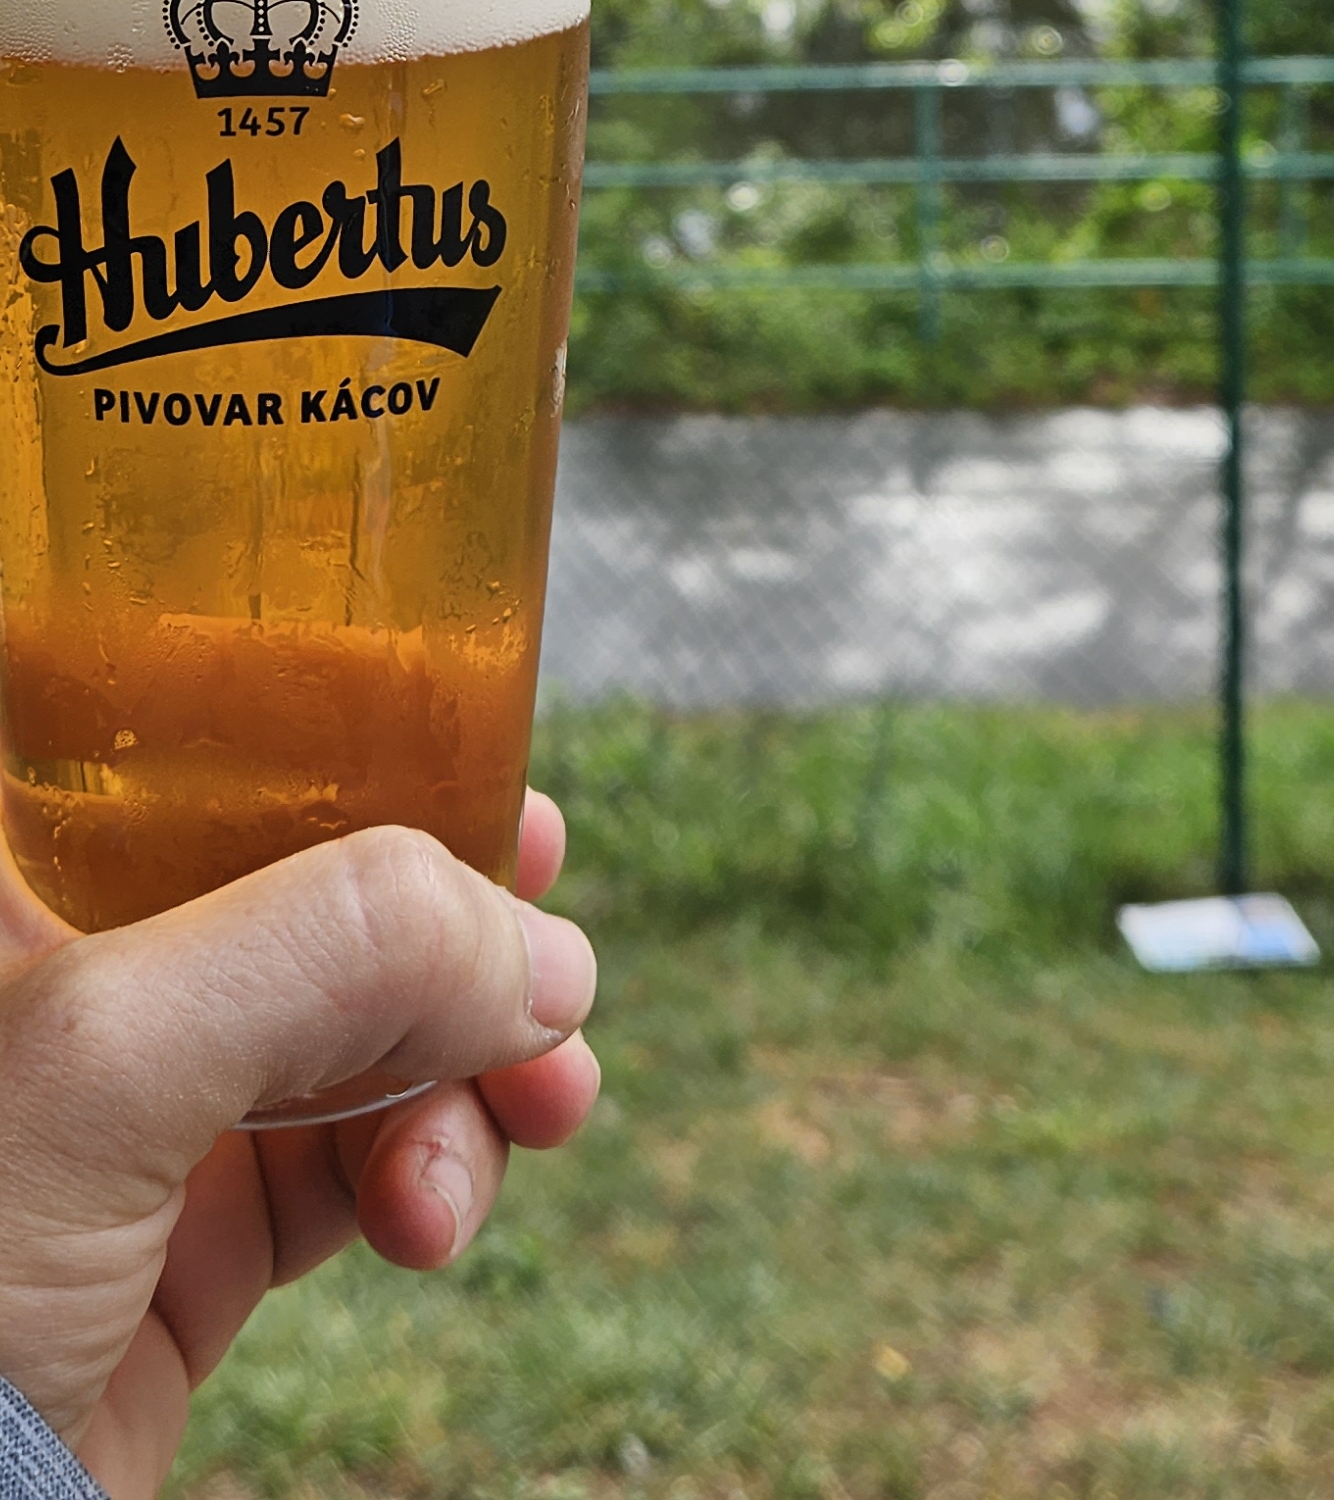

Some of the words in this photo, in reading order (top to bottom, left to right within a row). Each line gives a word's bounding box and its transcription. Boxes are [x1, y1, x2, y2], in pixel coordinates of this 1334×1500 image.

[217, 106, 310, 137] 1457
[18, 135, 507, 348] Hubertus
[94, 388, 283, 426] PIVOVAR
[301, 377, 441, 423] KÁCOV
